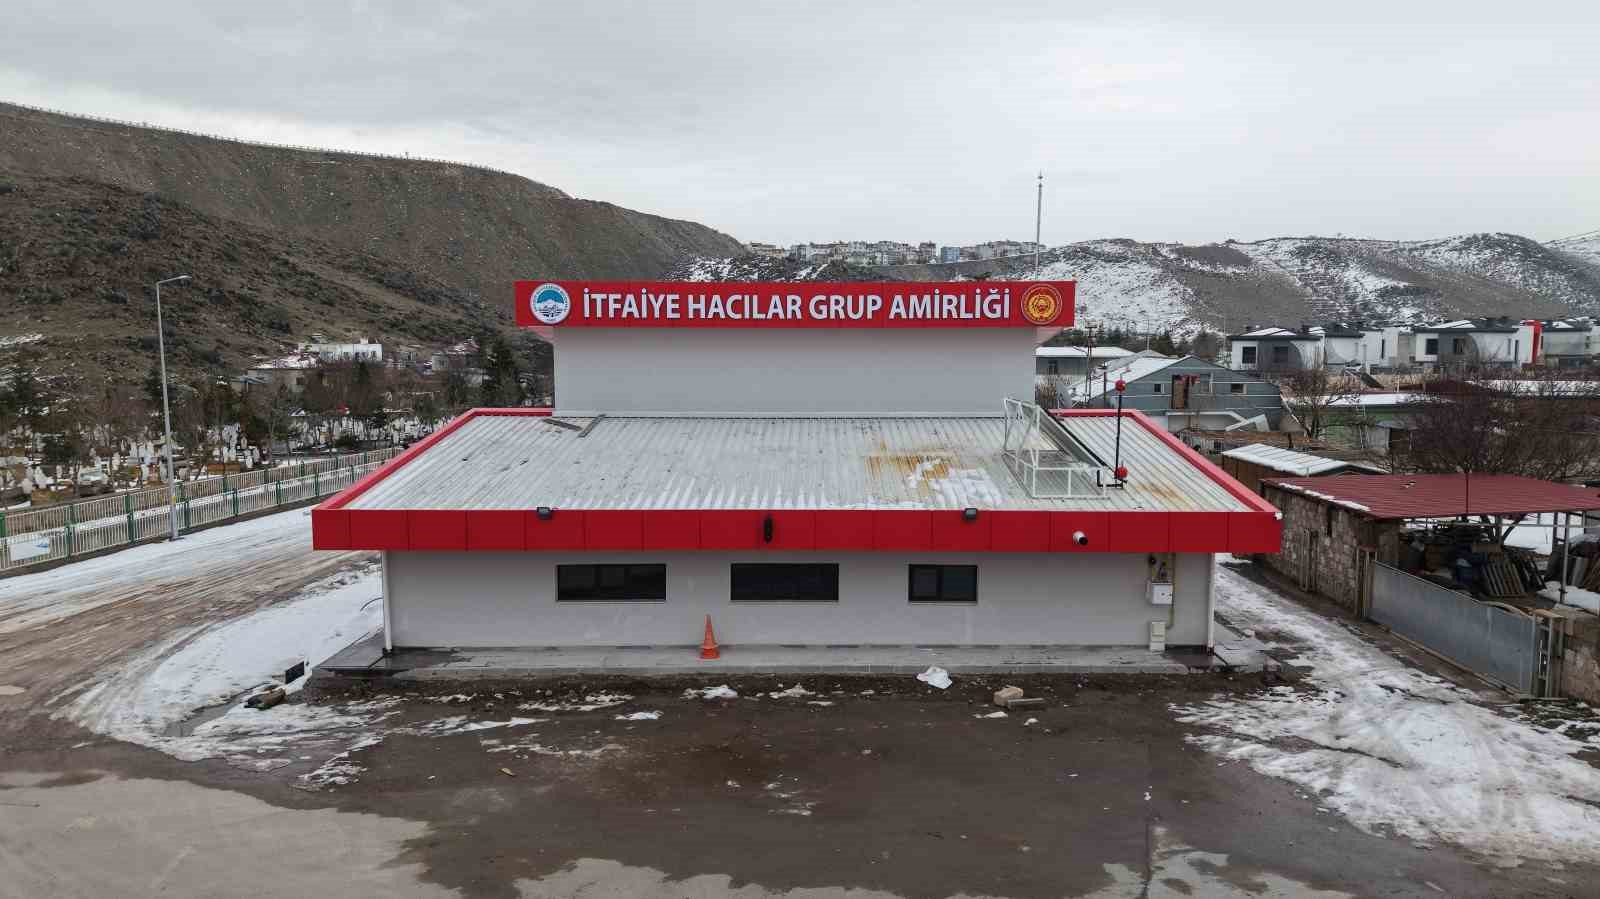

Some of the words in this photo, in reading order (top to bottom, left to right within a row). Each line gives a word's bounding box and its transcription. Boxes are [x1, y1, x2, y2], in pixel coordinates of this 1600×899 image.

[583, 287, 681, 319] İTFAİYE
[687, 295, 804, 319] HACILAR
[808, 294, 882, 320] GRUP
[888, 287, 1011, 320] AMİRLİĞİ
